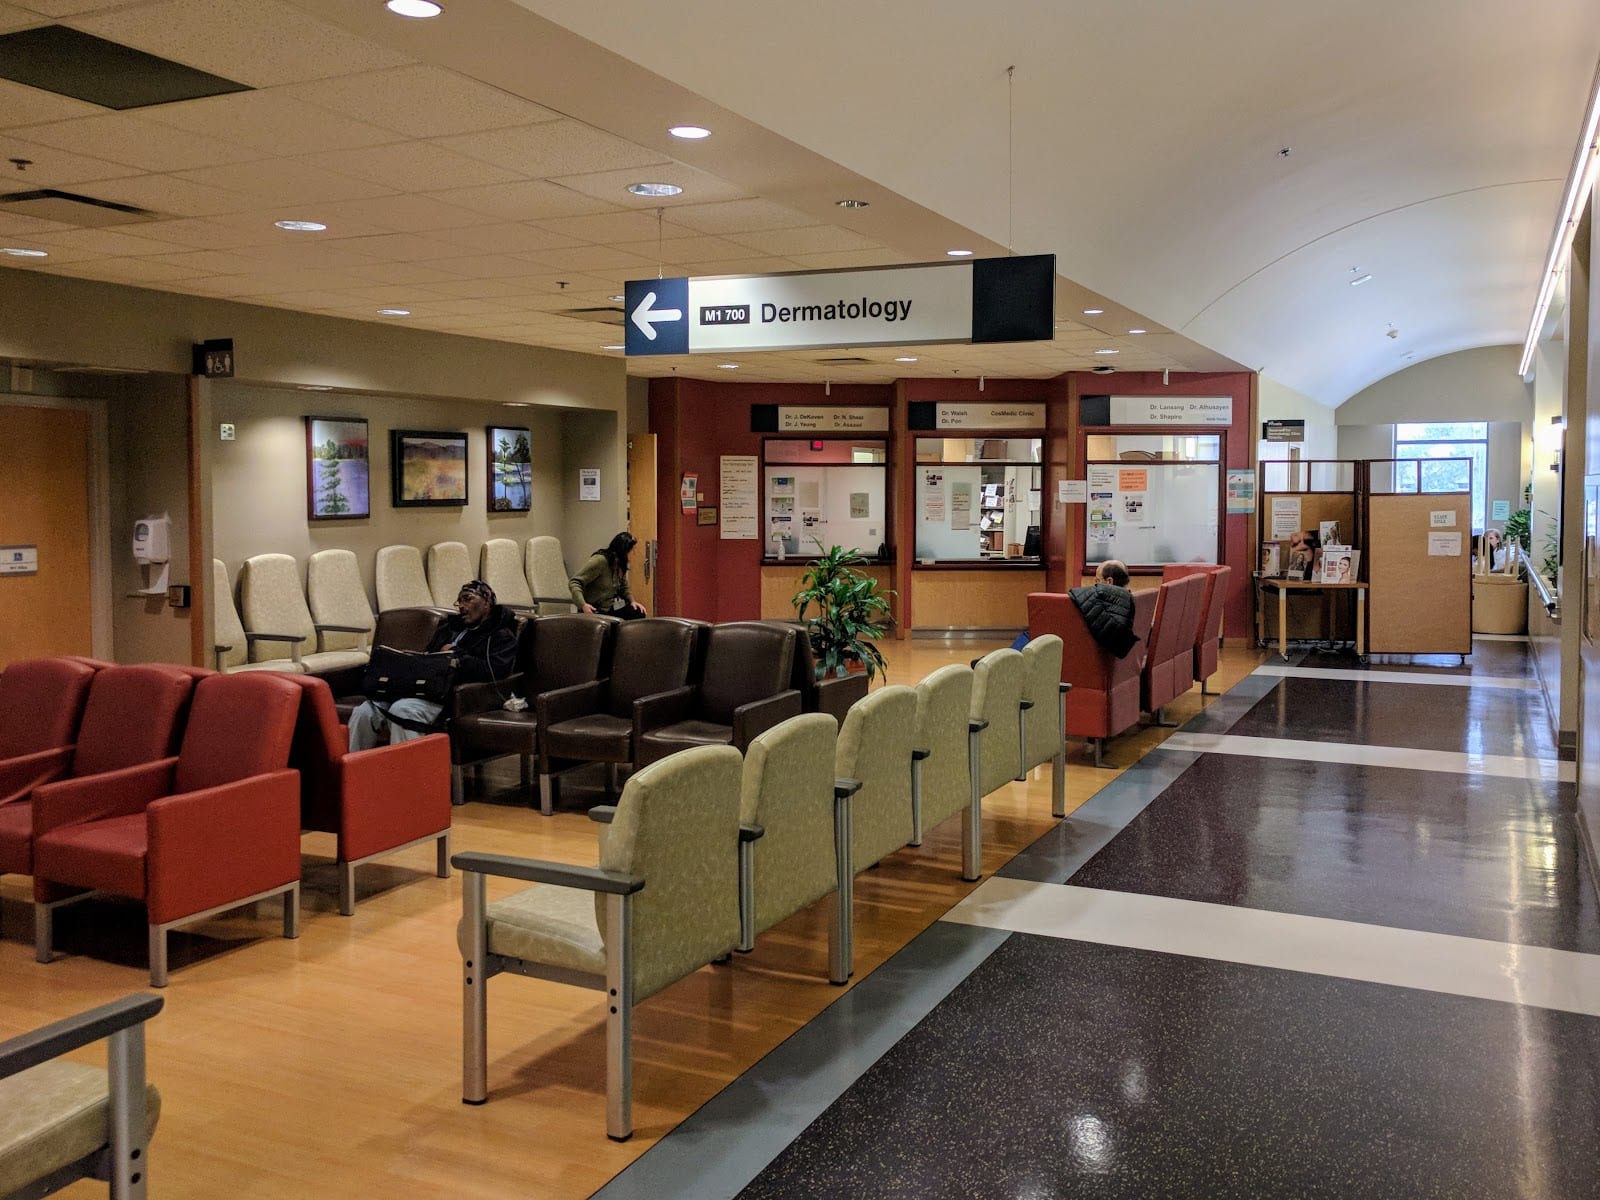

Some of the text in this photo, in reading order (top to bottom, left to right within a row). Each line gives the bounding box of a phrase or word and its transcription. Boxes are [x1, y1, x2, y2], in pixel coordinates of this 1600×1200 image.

[705, 297, 913, 324] M1 700 Dermatology
